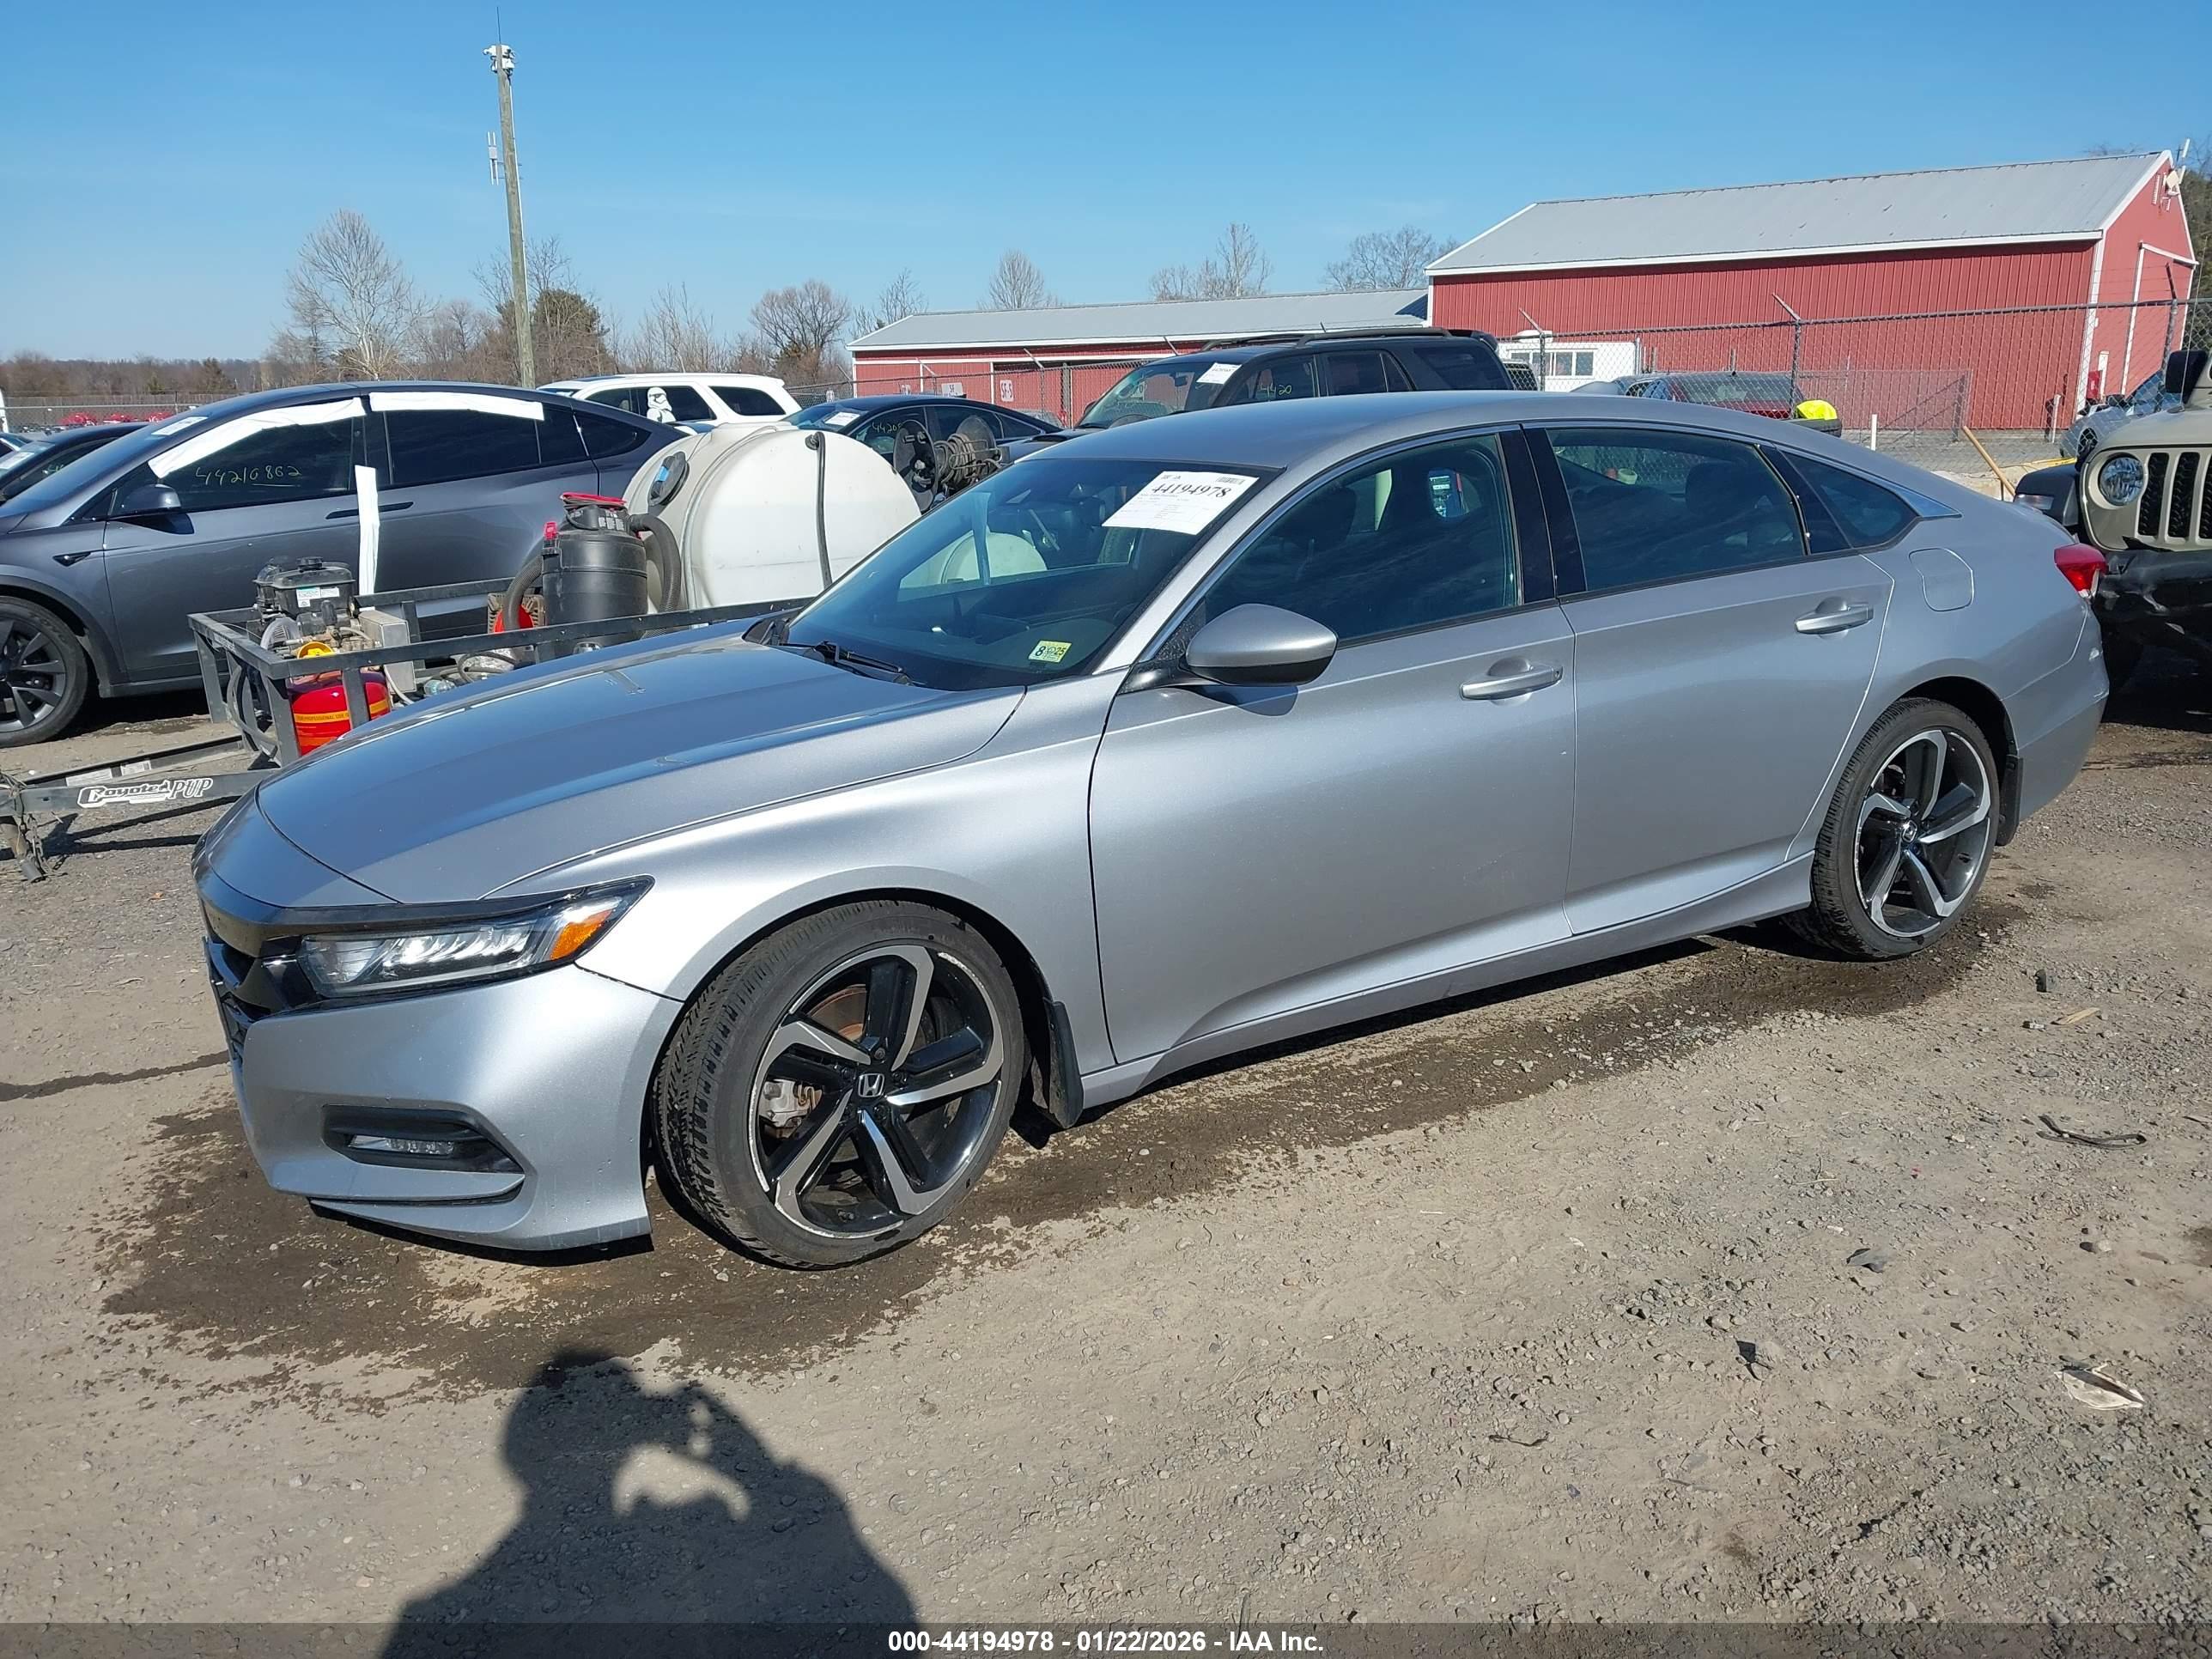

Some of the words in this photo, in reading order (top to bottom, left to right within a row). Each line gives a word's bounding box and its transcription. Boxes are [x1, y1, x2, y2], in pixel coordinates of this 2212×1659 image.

[1152, 483, 1232, 498] 44194978
[1035, 646, 1046, 657] 8
[167, 777, 214, 799] PUP
